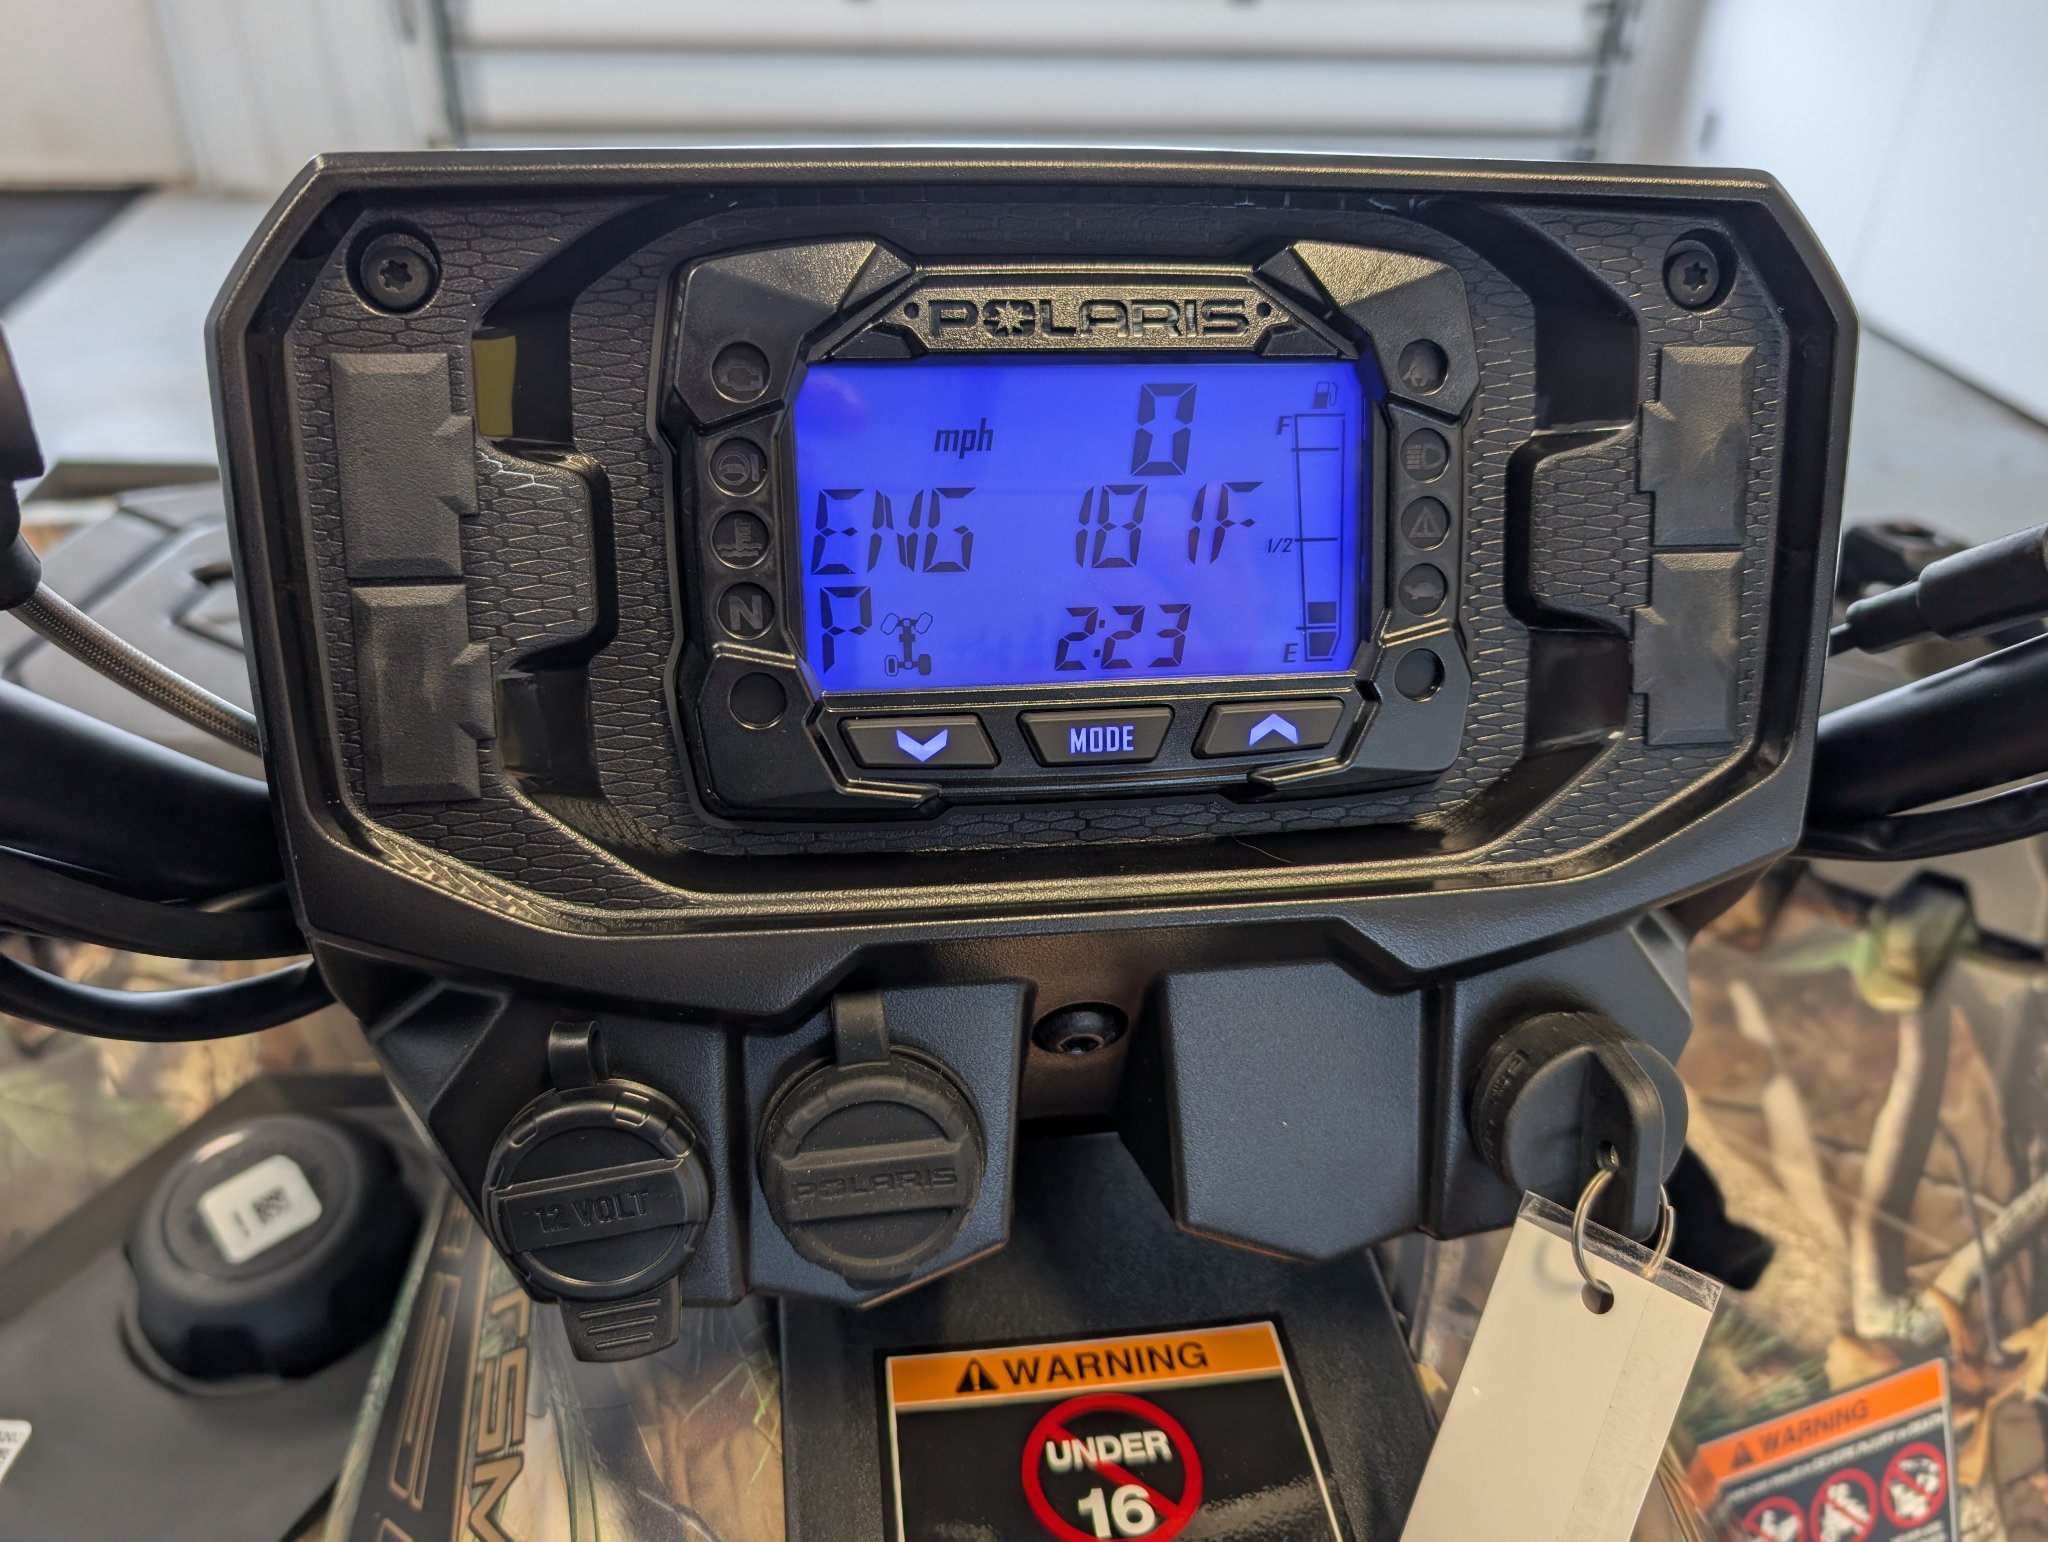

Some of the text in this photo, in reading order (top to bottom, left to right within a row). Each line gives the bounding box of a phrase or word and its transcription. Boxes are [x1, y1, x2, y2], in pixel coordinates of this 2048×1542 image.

[929, 300, 1250, 337] POLARIS
[934, 418, 993, 459] mph
[1131, 383, 1196, 476] 0
[1276, 417, 1291, 435] F
[811, 487, 976, 574] ENG
[1267, 538, 1292, 554] 1/2
[729, 595, 762, 630] N
[820, 586, 871, 674] P
[1055, 604, 1191, 671] 2:23
[1283, 644, 1296, 663] E
[1069, 725, 1134, 755] MODE
[795, 1167, 958, 1199] POLARIS
[534, 1192, 649, 1234] 12 VOLT
[1003, 1342, 1208, 1386] WARNING
[1760, 1399, 1869, 1452] WARNING
[1046, 1430, 1173, 1472] UNDER
[1077, 1484, 1156, 1540] 16
